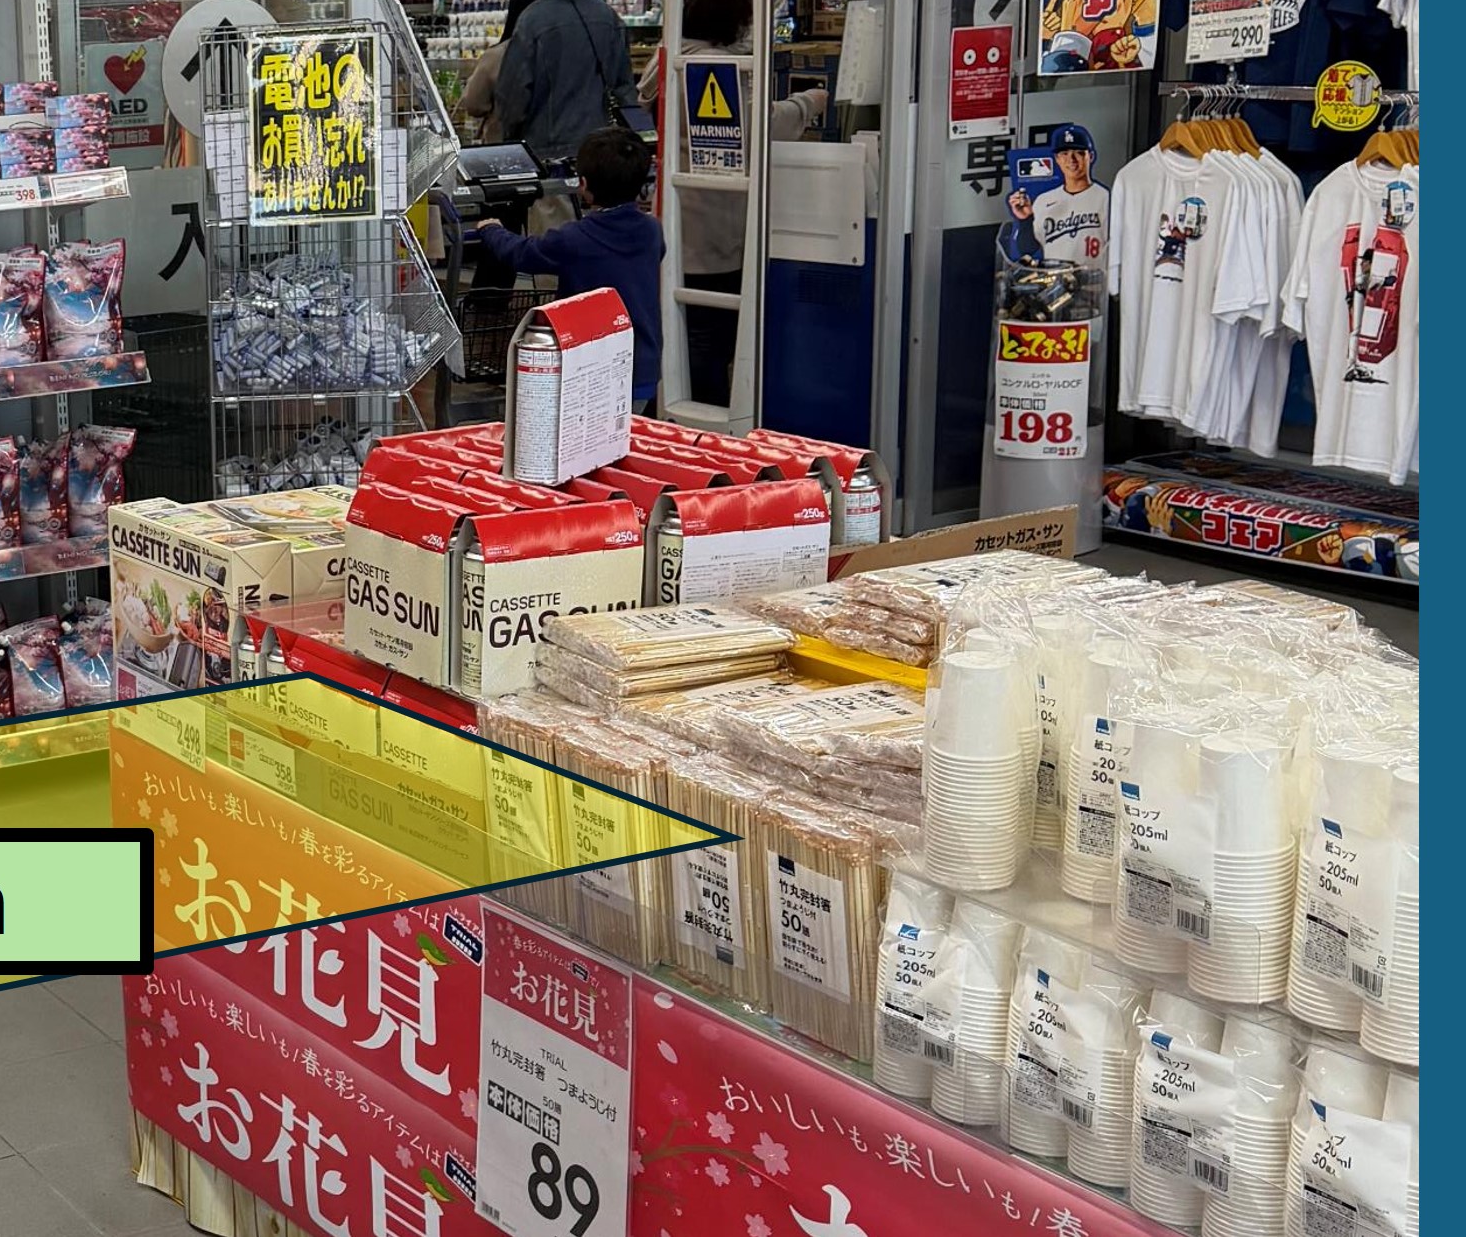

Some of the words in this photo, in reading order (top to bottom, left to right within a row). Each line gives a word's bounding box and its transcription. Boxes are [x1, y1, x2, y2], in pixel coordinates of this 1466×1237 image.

[260, 51, 365, 111] 電池の
[262, 112, 366, 169] お買い忘れ
[690, 124, 741, 138] WARNING
[15, 188, 37, 203] 398
[1043, 209, 1102, 243] Dodgers
[1084, 234, 1100, 258] 18
[1000, 323, 1088, 361] とっておき!
[999, 410, 1074, 444] 198
[1058, 446, 1078, 457] 217
[974, 523, 1064, 552] カセットガス・サン
[1201, 510, 1282, 556] フェア
[111, 524, 171, 568] CASSETTE
[172, 548, 202, 579] SUN
[346, 556, 390, 584] CASSETTE
[346, 574, 391, 616] GAS
[393, 591, 440, 637] SUN
[489, 591, 562, 614] CASSETTE
[288, 698, 329, 732] CASSETTE
[273, 759, 293, 783] 358
[382, 739, 428, 772] CASSETTE
[329, 776, 359, 813] GAS
[360, 788, 395, 828] SUN
[1324, 839, 1358, 863] 紙コップ
[174, 836, 452, 1098] お花見
[896, 942, 937, 959] 紙コップ
[509, 961, 600, 1043] お花見
[490, 1038, 546, 1082] 竹丸完封箸
[539, 1047, 567, 1072] TRIAL
[527, 1141, 600, 1237] 89
